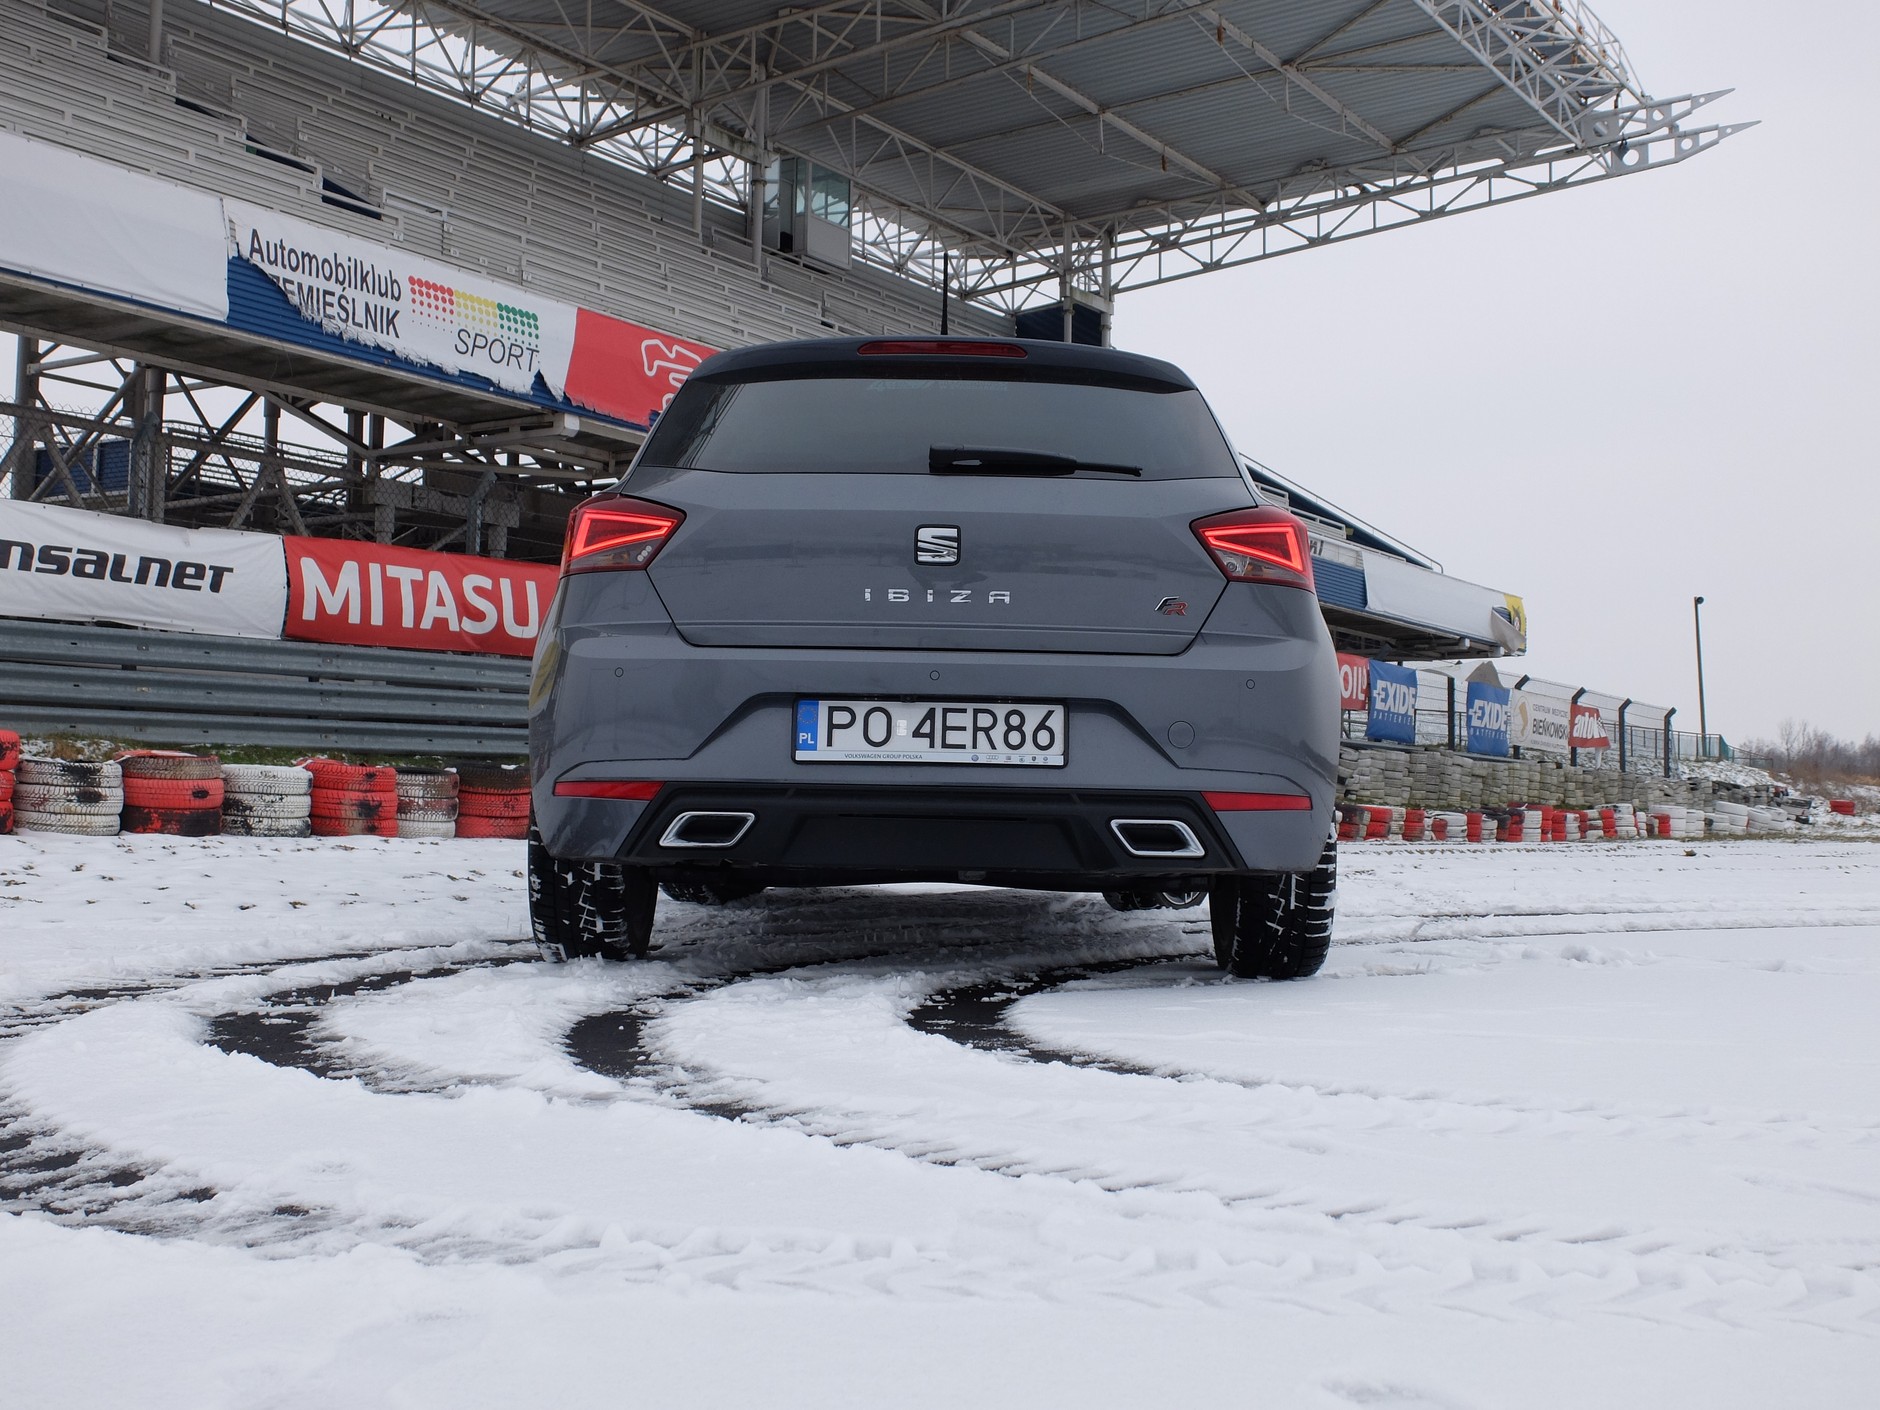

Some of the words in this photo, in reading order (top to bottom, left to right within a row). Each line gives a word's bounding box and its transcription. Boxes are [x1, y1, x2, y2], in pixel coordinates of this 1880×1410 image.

[250, 228, 402, 302] Automobilklub
[454, 328, 540, 372] SPORT
[300, 556, 539, 639] MITASU
[864, 588, 1011, 604] IBIZA
[1154, 595, 1189, 616] FR
[1374, 679, 1417, 717] EXIDE
[1469, 699, 1508, 732] EXIDE
[799, 732, 815, 744] PL
[826, 705, 893, 748] PO
[911, 707, 1056, 751] 4ER86
